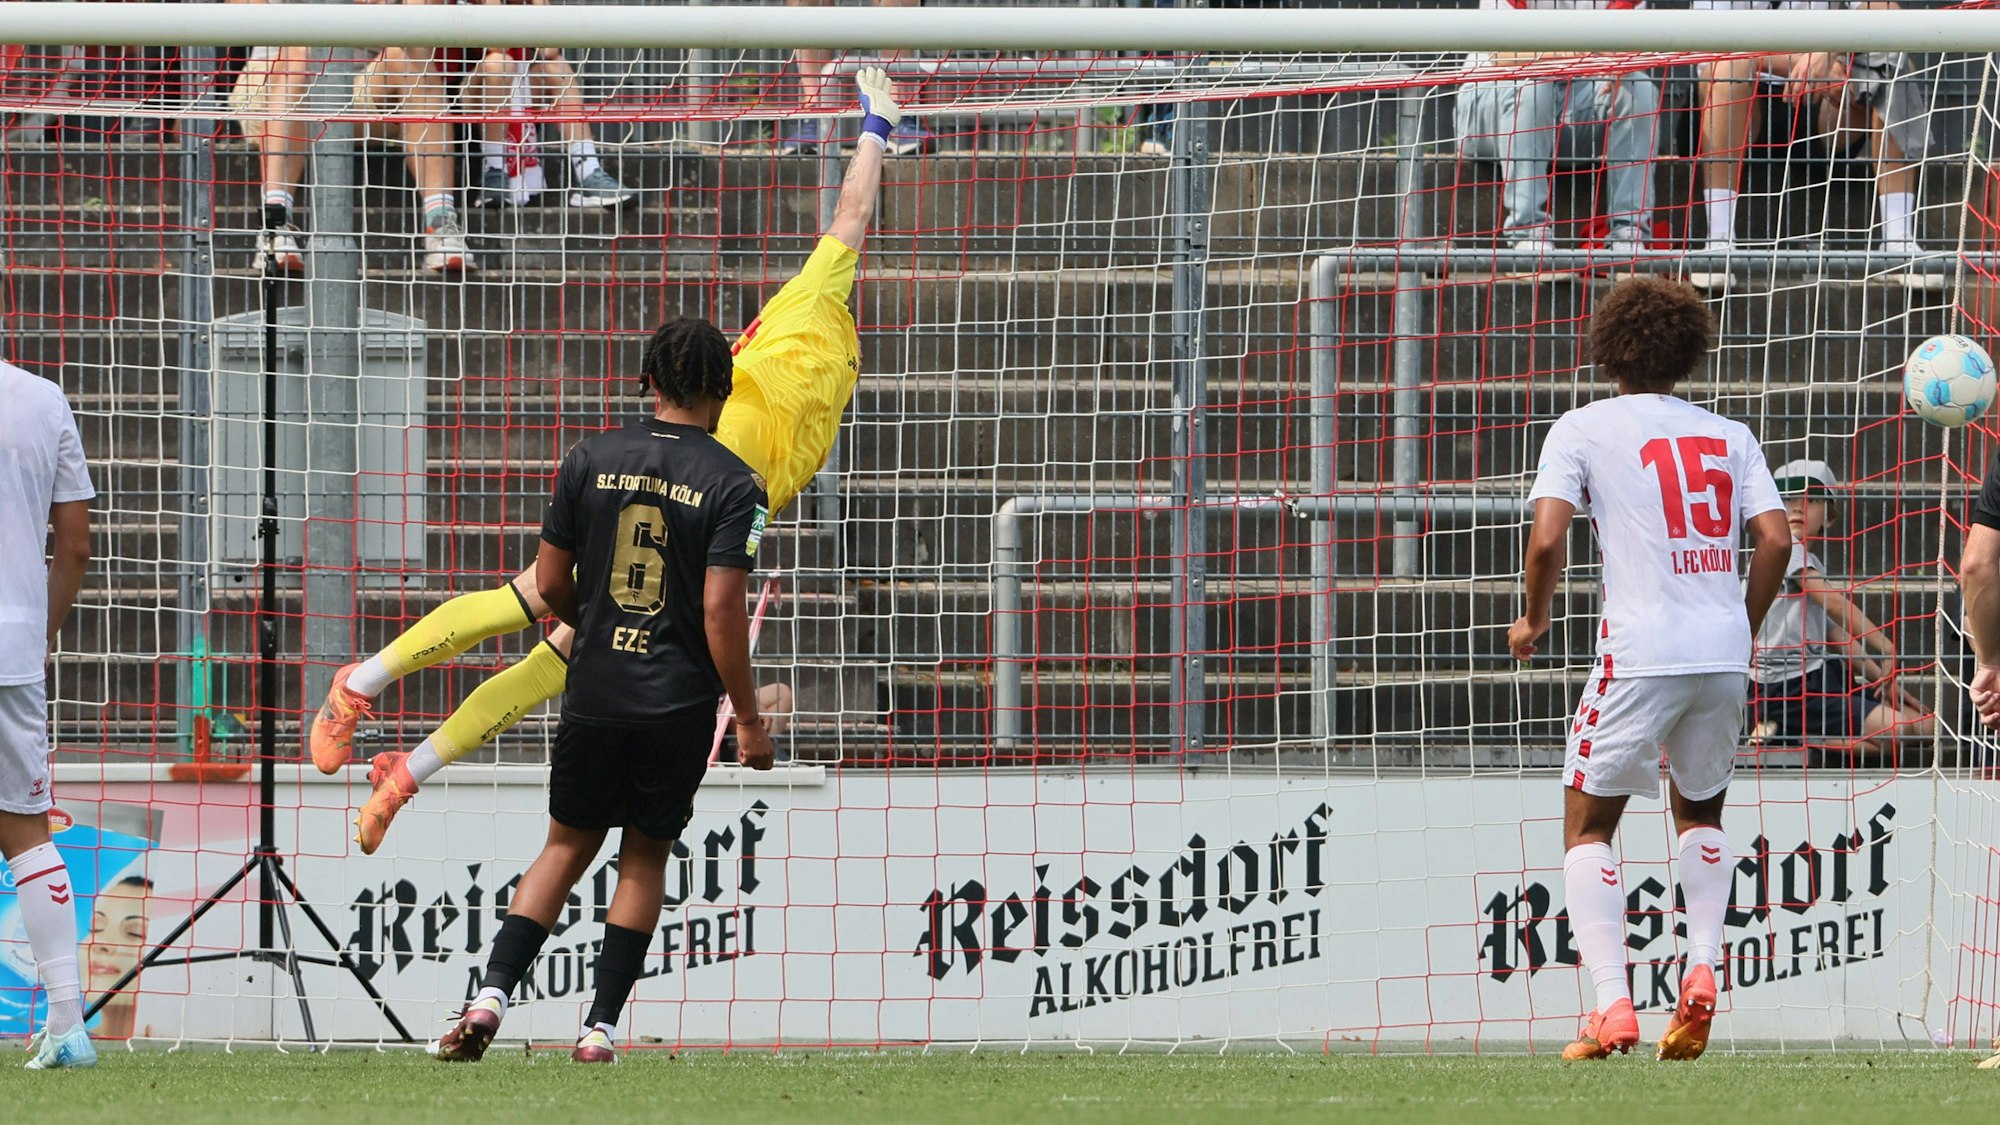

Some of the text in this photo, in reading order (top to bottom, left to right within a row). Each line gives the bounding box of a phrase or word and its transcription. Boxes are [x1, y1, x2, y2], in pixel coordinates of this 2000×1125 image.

[597, 474, 703, 508] S.C. FORTUNA KÖLN
[1640, 436, 1733, 539] 15
[609, 504, 668, 615] 6
[1700, 544, 1731, 572] KÖLN
[612, 626, 650, 654] EZE
[913, 801, 1334, 981] Reissdorf
[1479, 802, 1896, 983] Resdorf
[465, 906, 755, 1008] AKOHFREI
[1029, 908, 1320, 1018] ALKOHOLFREI
[1625, 908, 1884, 1011] LKHOLFREI
